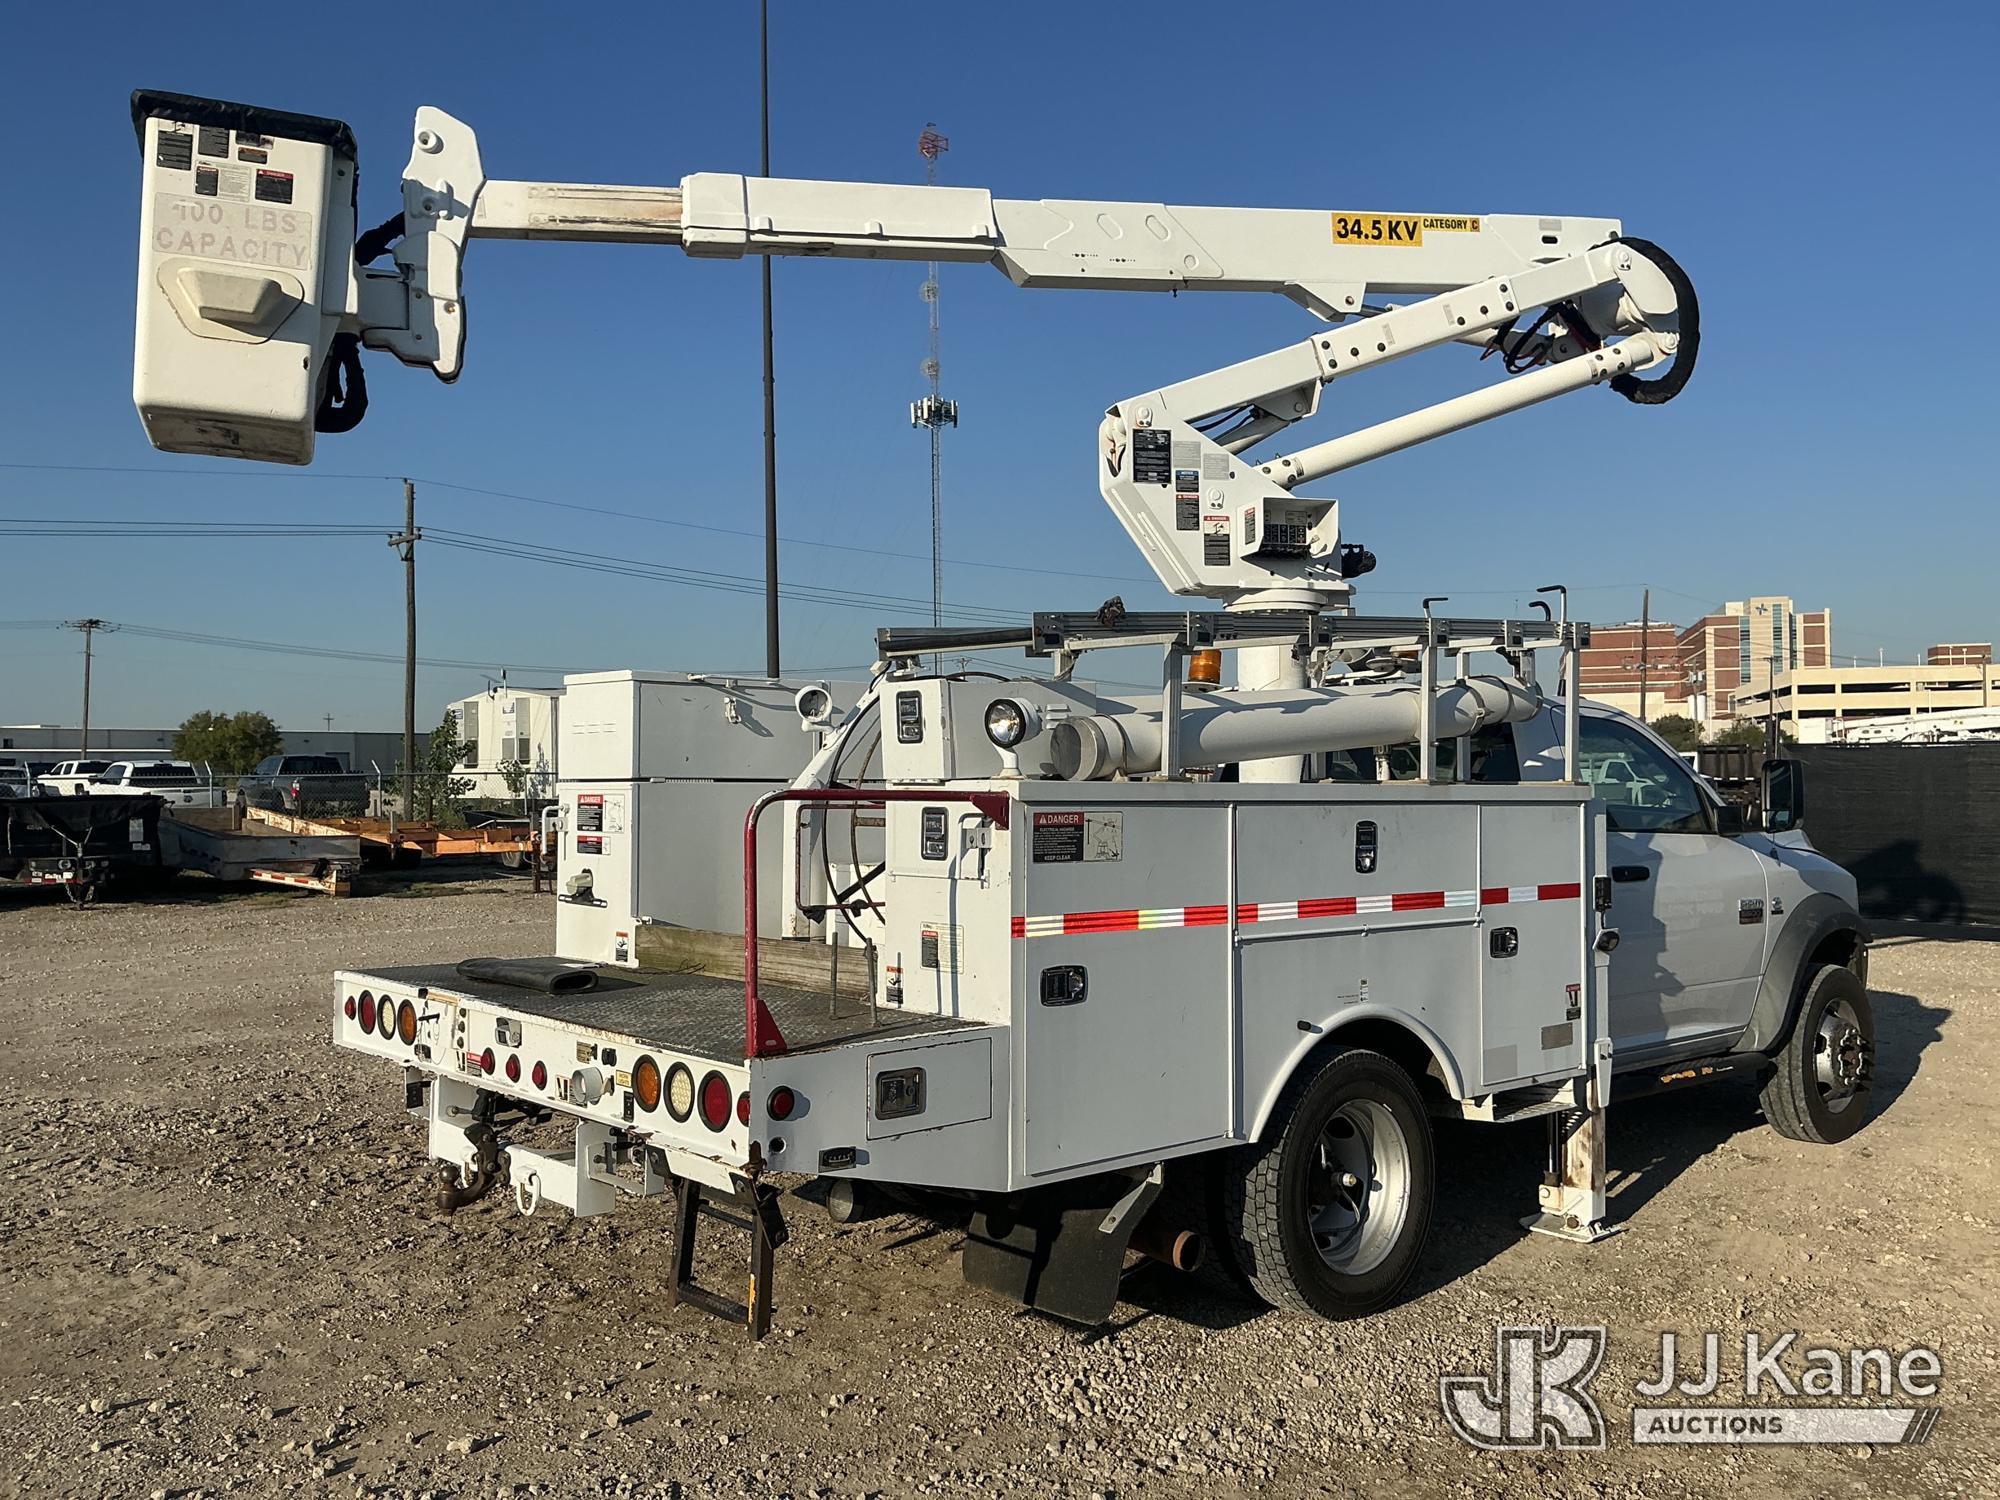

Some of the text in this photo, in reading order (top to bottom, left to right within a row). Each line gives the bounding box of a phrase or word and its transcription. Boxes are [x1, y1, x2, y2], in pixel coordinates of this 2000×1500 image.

[244, 207, 297, 233] LBS
[1336, 217, 1418, 241] 34.5 KV
[1423, 218, 1478, 230] CATEGORY C
[156, 227, 306, 266] CAPACITY
[1047, 814, 1079, 824] DANGER
